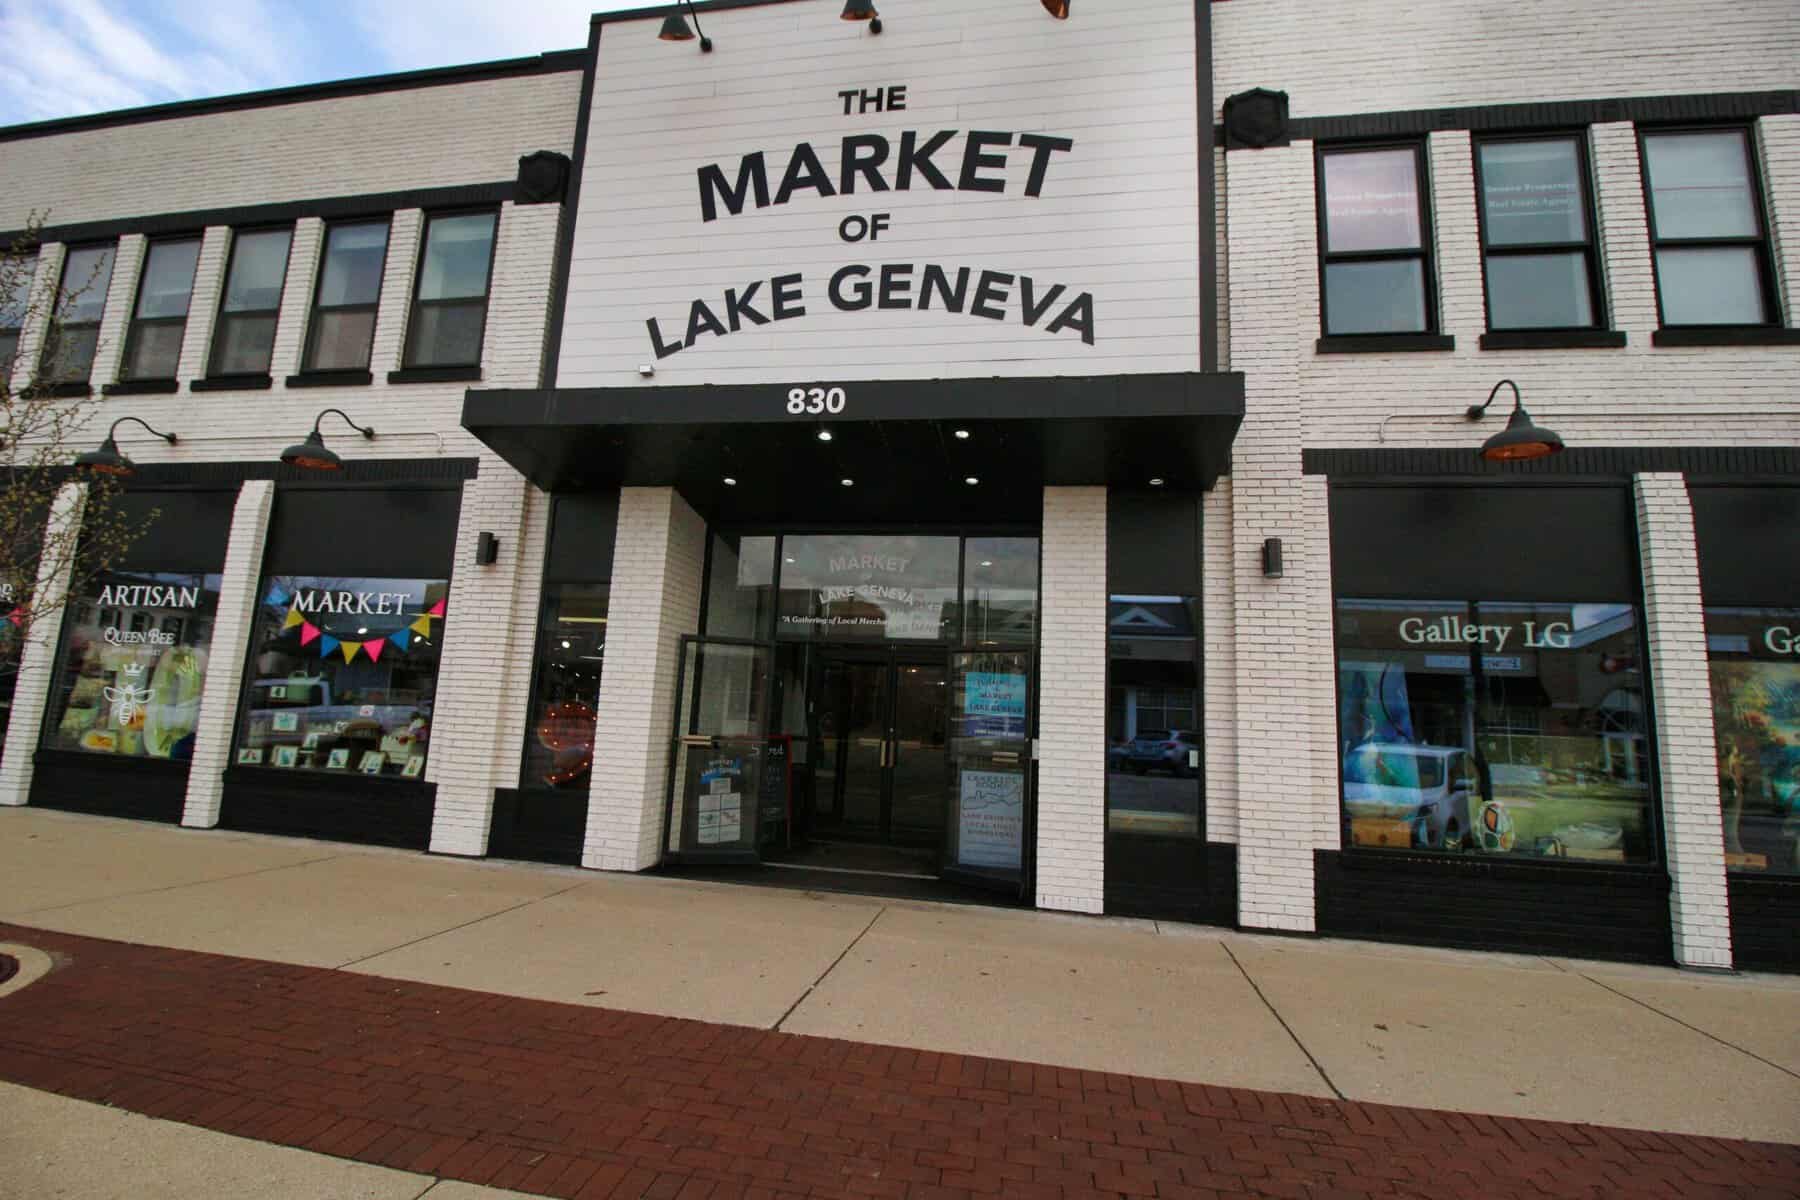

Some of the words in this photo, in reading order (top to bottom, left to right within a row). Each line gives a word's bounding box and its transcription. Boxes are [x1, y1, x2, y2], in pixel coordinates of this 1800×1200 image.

[838, 86, 907, 115] THE
[697, 130, 1073, 223] MARKET
[839, 213, 890, 242] OF
[646, 273, 806, 360] LAKE
[828, 263, 1095, 346] GENEVA
[786, 387, 846, 414] 830
[830, 554, 911, 573] MARKET
[97, 585, 200, 608] ARTISAN
[292, 590, 413, 616] MARKET
[819, 586, 855, 604] LAKE
[858, 585, 913, 607] GENEVA
[1400, 616, 1512, 652] Gallery
[1522, 621, 1571, 648] LG
